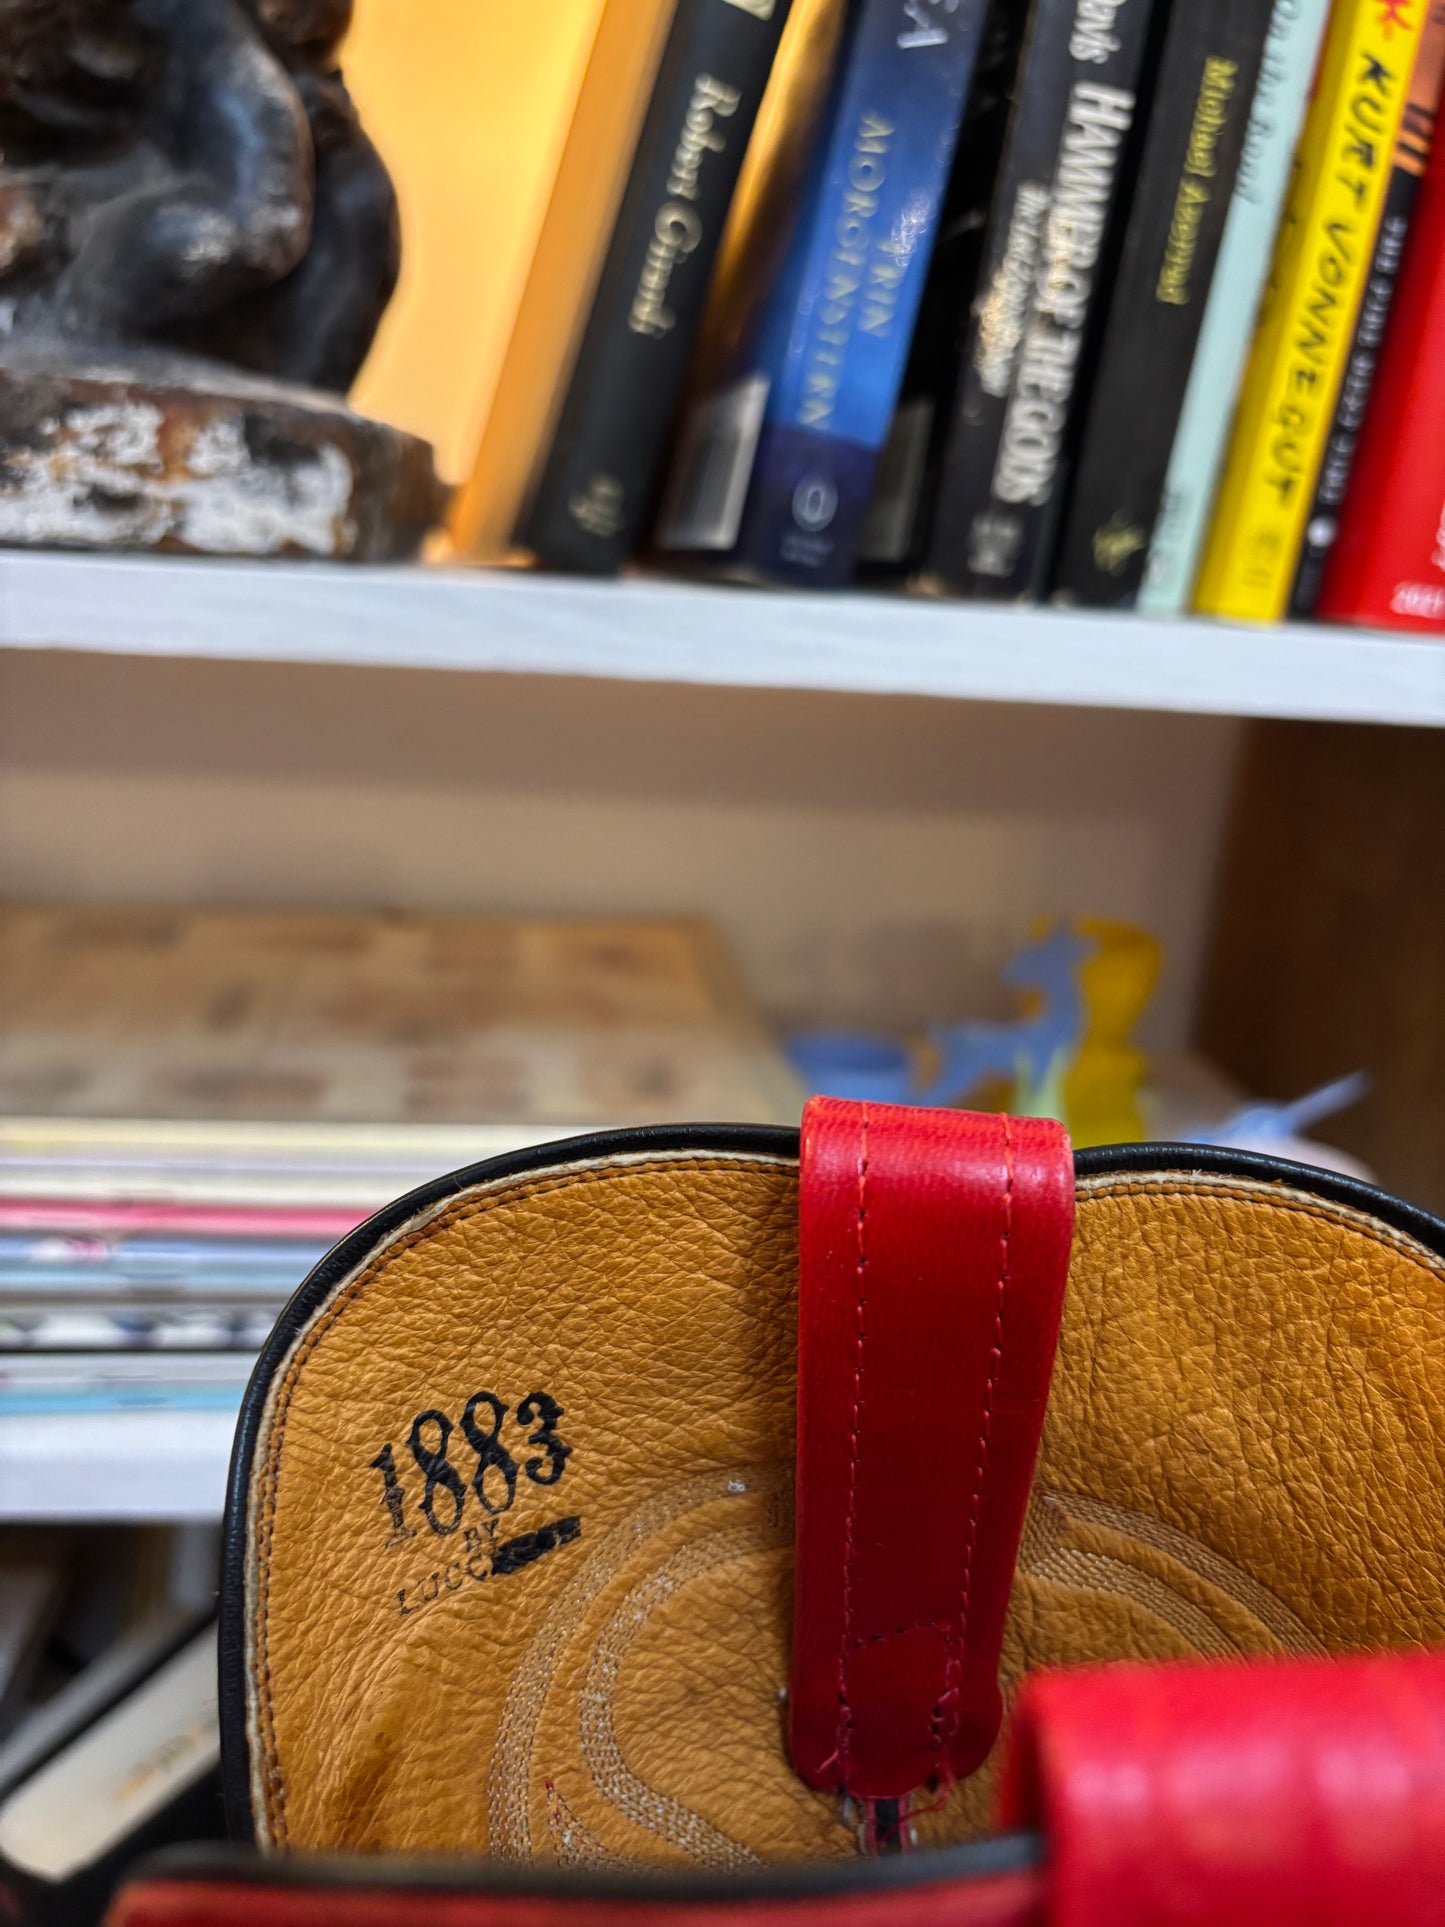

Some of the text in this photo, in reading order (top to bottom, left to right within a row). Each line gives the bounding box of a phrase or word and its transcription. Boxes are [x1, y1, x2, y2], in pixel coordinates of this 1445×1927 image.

[668, 73, 741, 199] Robert
[1046, 82, 1136, 270] HAMMER
[1186, 56, 1239, 178] Michael
[799, 113, 895, 428] MORGENSTERN
[1035, 263, 1091, 328] OF
[1268, 52, 1393, 500] KURT VONNEGUT
[1018, 328, 1081, 401] THE
[993, 395, 1065, 508] GODS
[371, 1391, 572, 1548] 1883
